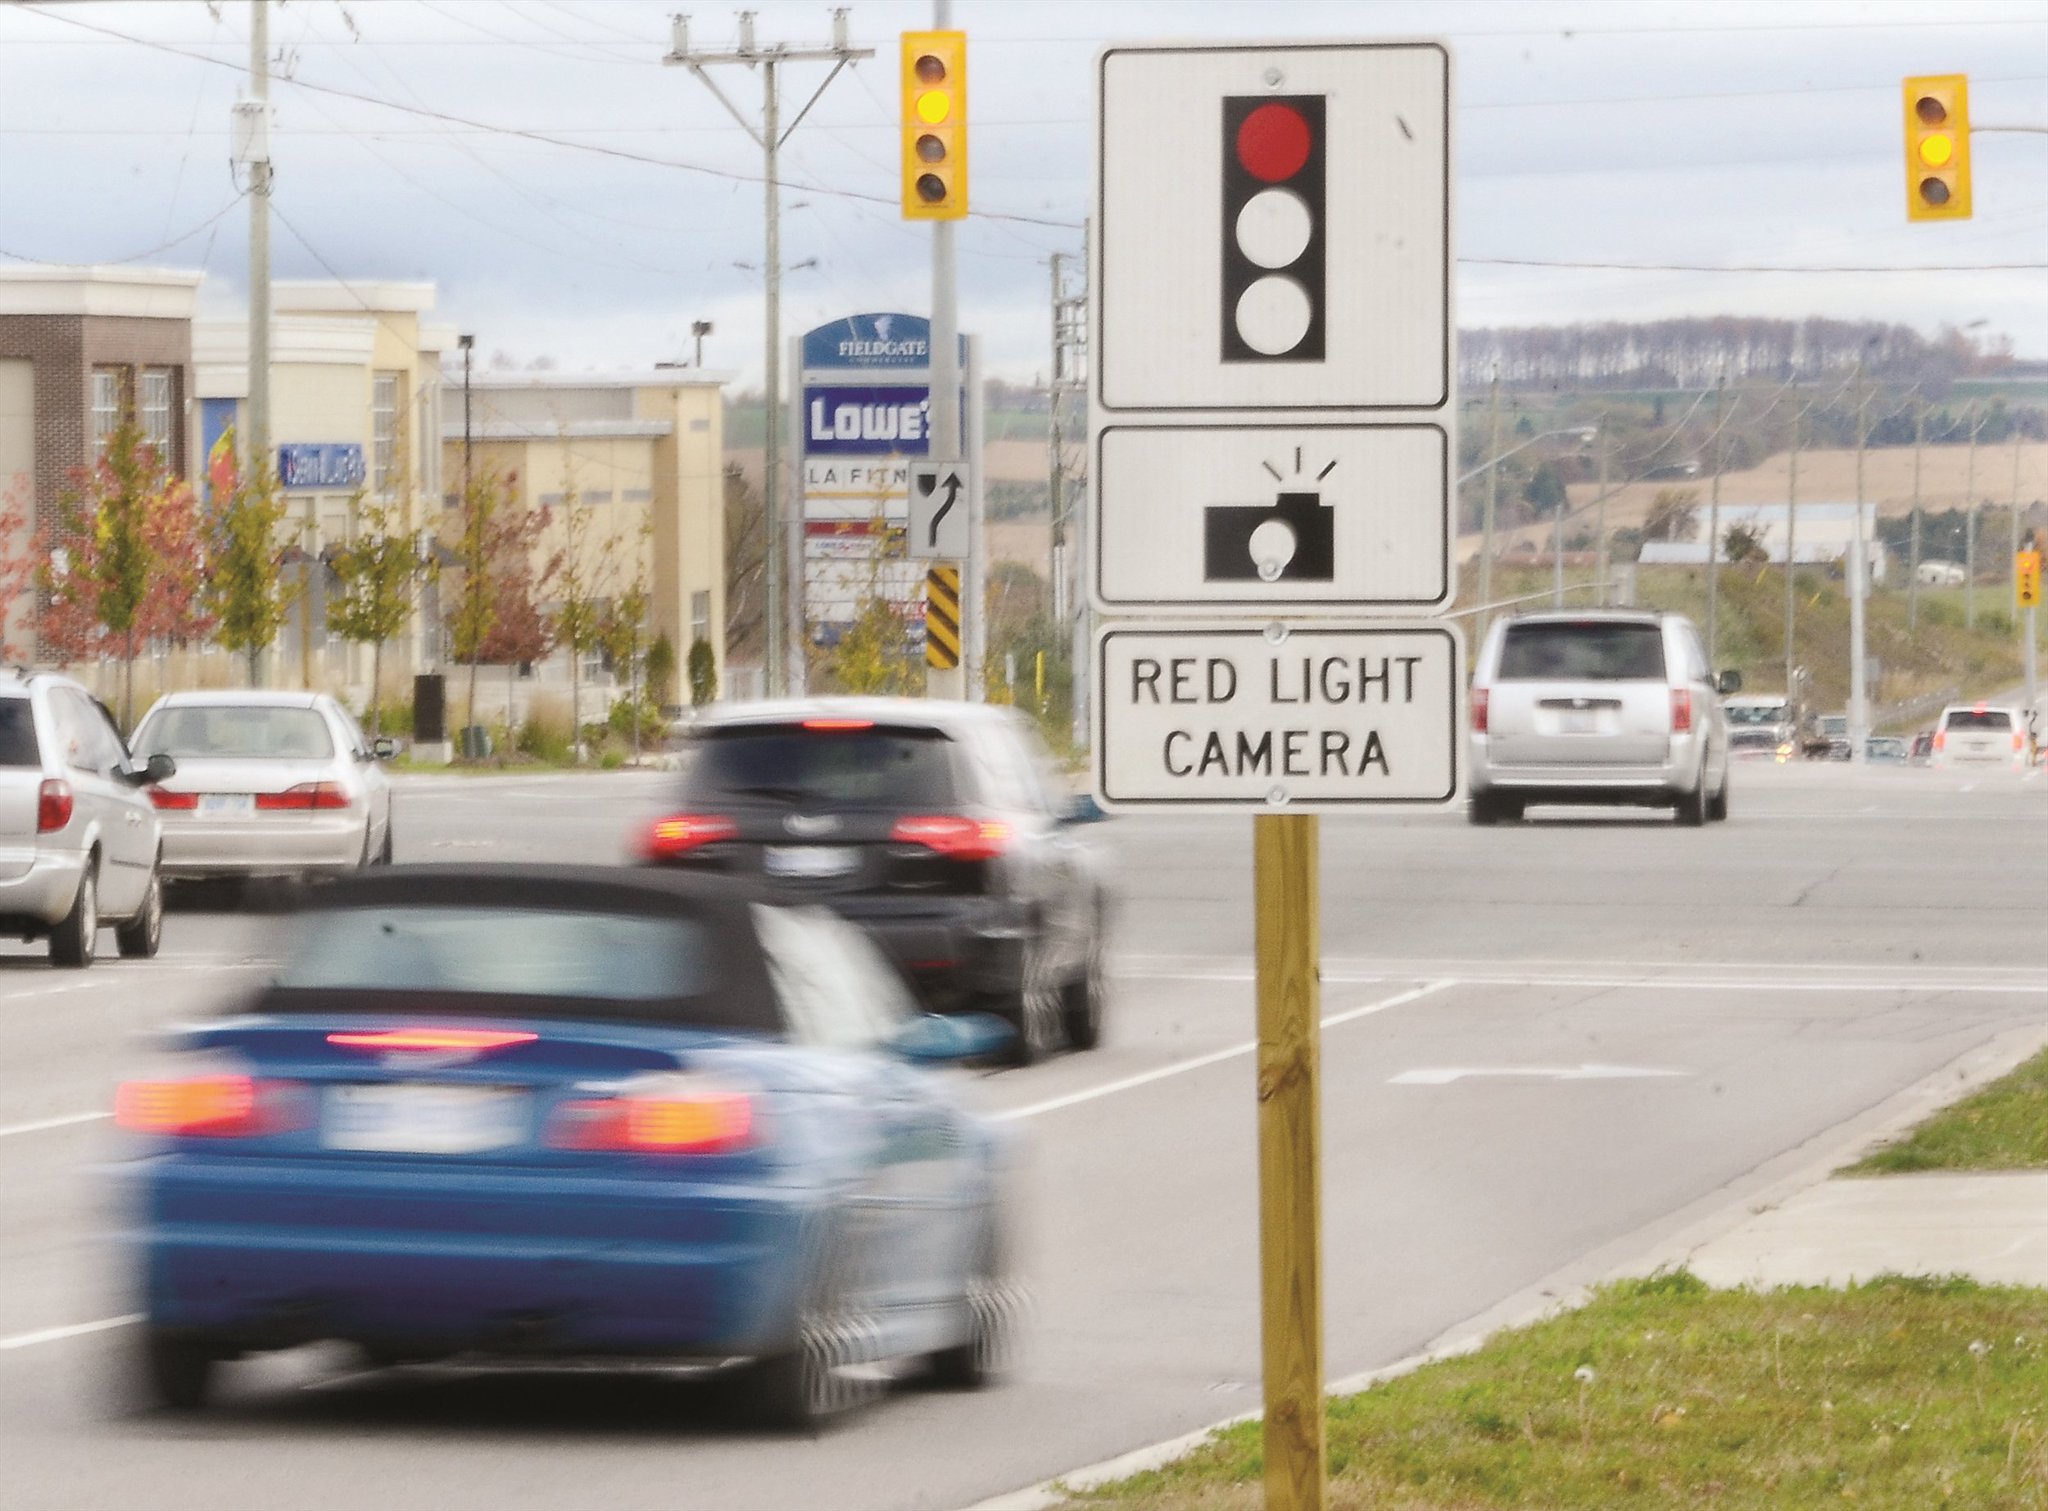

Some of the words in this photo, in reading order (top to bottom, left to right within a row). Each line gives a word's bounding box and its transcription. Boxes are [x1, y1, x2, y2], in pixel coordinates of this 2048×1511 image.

[839, 341, 926, 356] FIELDGATE
[811, 398, 930, 440] LOWE'
[810, 468, 837, 483] LA
[851, 468, 907, 483] FITN
[1131, 658, 1237, 704] RED
[1270, 657, 1422, 704] LIGHT
[1163, 731, 1390, 776] CAMERA
